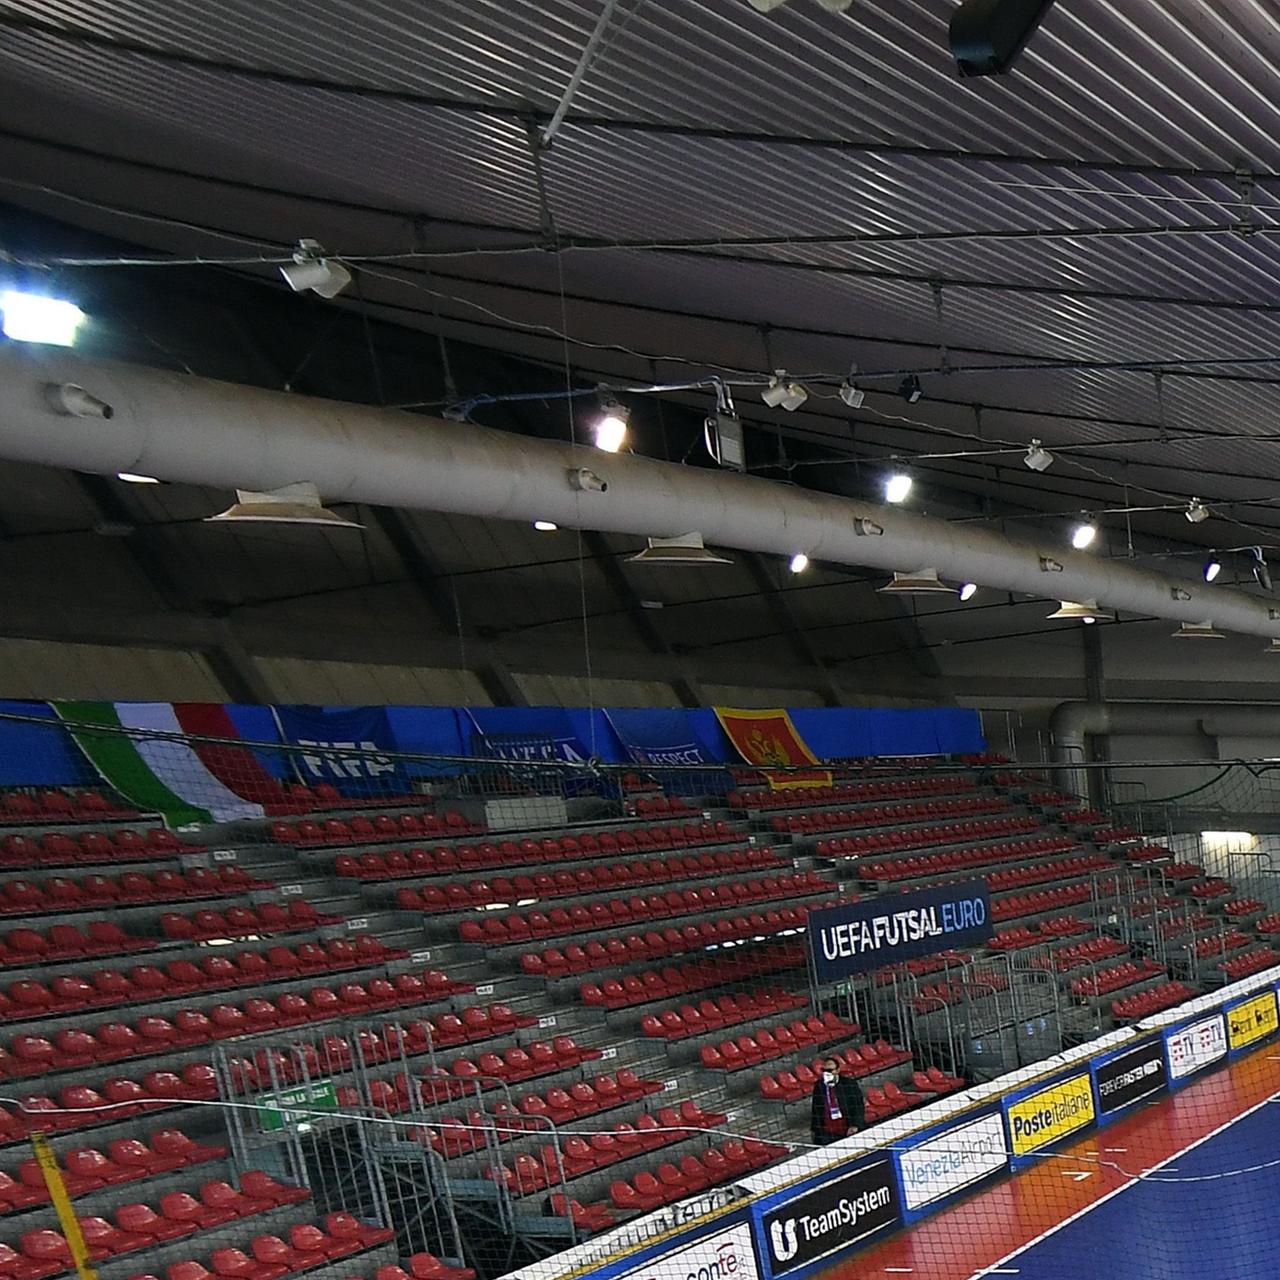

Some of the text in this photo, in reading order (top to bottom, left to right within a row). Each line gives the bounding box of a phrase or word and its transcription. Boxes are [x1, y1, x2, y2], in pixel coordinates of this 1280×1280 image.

[298, 740, 395, 777] FIFA
[649, 748, 704, 766] RESPECT
[799, 1186, 890, 1241] TeamSystem
